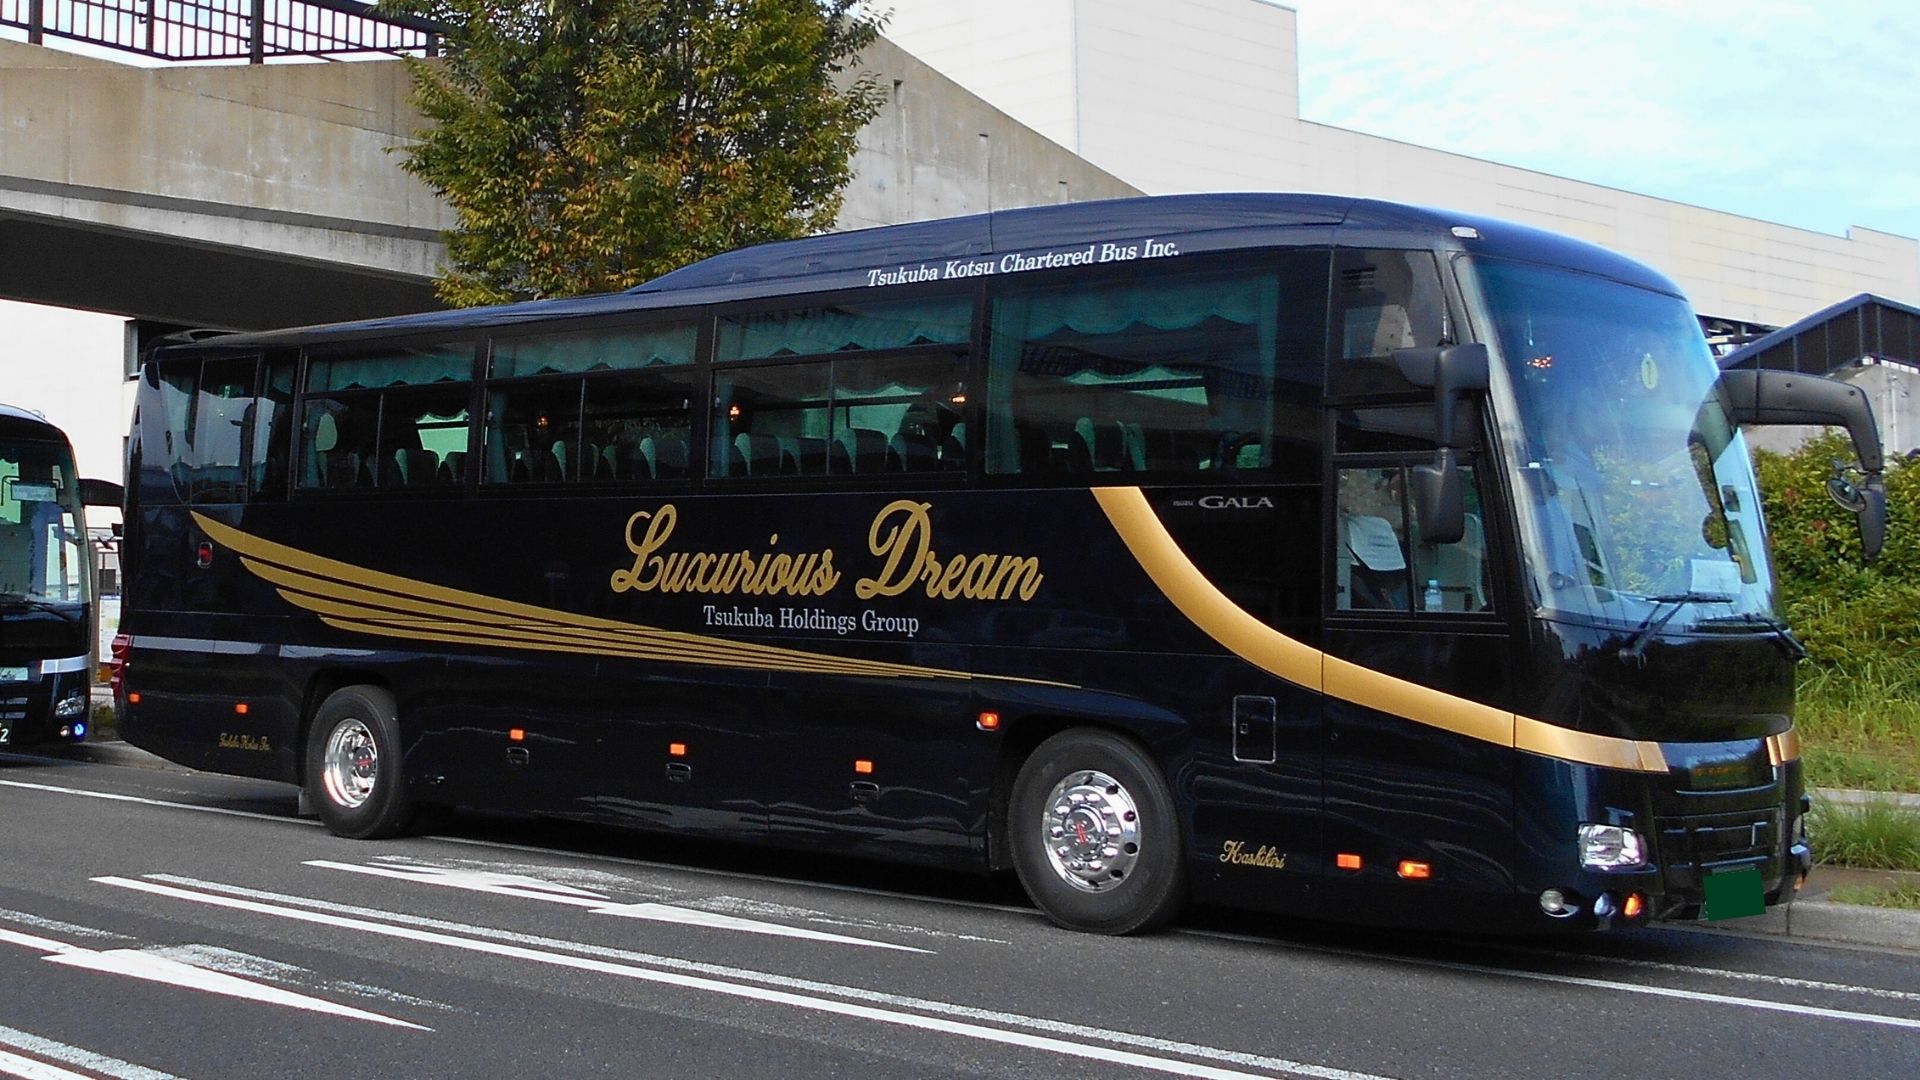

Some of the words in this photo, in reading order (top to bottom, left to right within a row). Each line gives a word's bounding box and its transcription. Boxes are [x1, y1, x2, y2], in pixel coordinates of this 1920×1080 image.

[867, 267, 938, 287] Tsukuba
[943, 259, 994, 279] Kotsu
[1000, 245, 1095, 274] Chartered
[1099, 243, 1137, 262] Bus
[1142, 239, 1180, 259] Inc.
[1198, 495, 1274, 509] GALA
[610, 503, 841, 597] Luxurious
[855, 499, 1044, 601] Dream
[703, 604, 775, 629] Tsukuba
[779, 608, 857, 632] Holdings
[861, 609, 920, 637] Group
